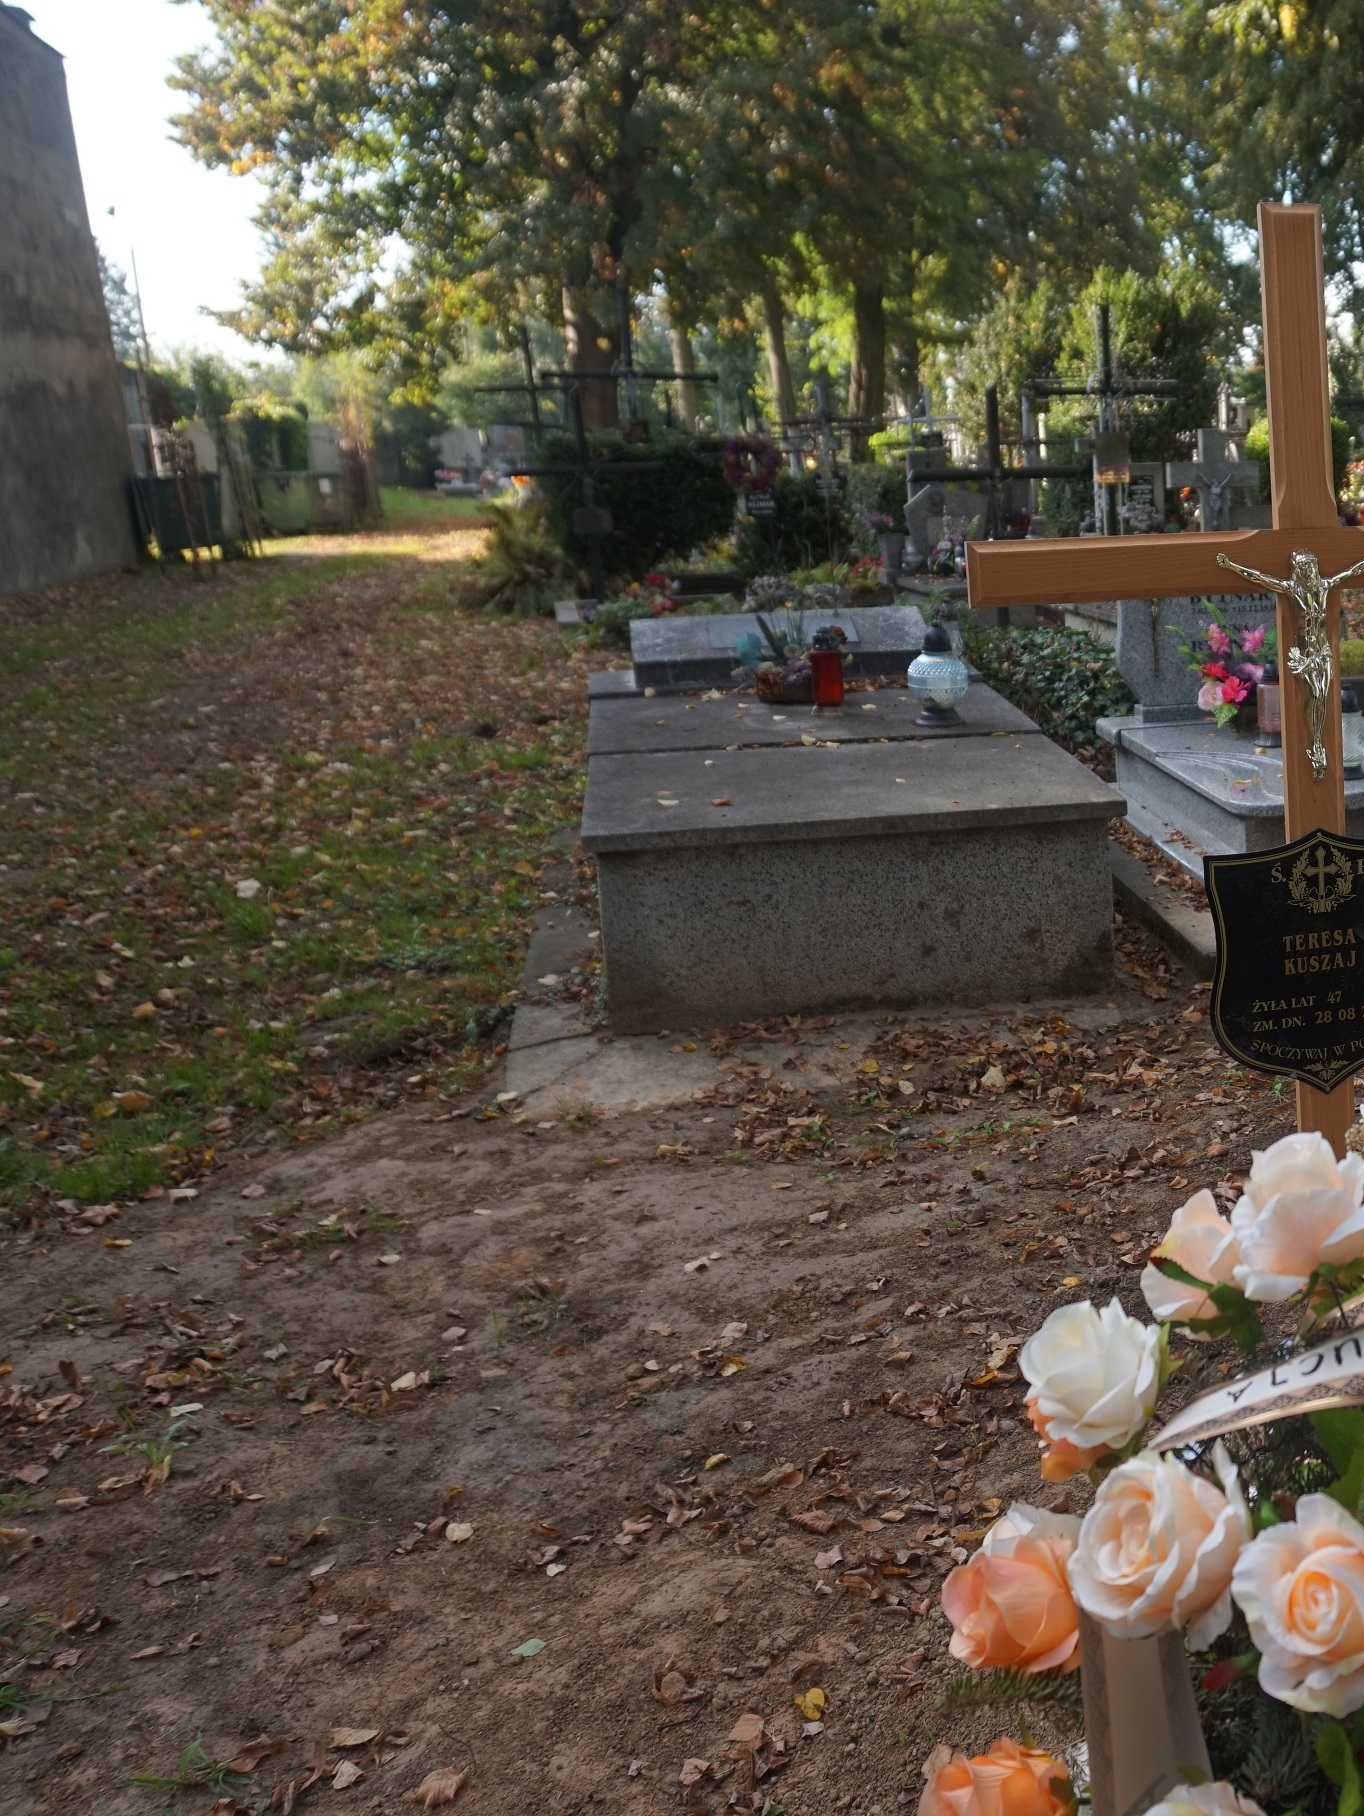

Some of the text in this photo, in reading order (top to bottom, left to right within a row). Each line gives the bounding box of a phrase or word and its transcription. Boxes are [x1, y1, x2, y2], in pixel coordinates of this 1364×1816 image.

[1270, 861, 1287, 883] Ś.
[1282, 928, 1357, 952] TERESA
[1284, 950, 1357, 976] KUSZAJ
[1252, 990, 1342, 1013] ŻYŁA LAT 47
[1253, 1020, 1278, 1032] ZM.
[1281, 1016, 1306, 1029] DN.
[1315, 1010, 1333, 1025] 28
[1338, 1007, 1356, 1021] 08
[1251, 1039, 1328, 1061] SPOCZYWAJ
[1333, 1044, 1346, 1057] W
